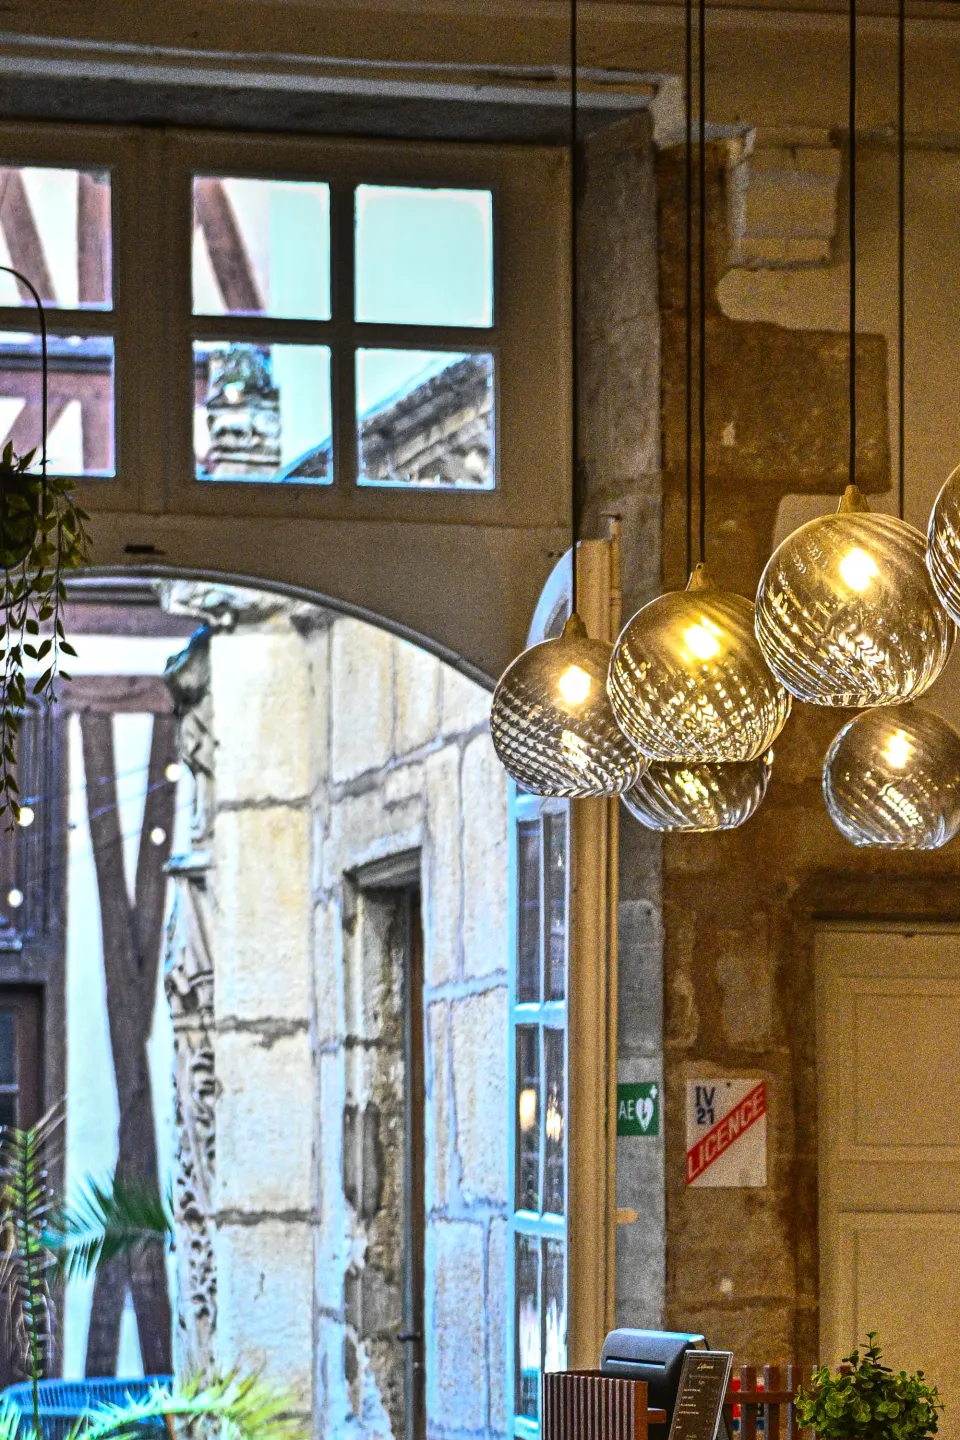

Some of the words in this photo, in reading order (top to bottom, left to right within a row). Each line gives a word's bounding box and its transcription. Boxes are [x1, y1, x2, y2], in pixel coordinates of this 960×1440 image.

[696, 1086, 716, 1107] IV
[618, 1097, 635, 1120] AE
[696, 1108, 716, 1125] 21
[688, 1086, 765, 1176] LICENCE
